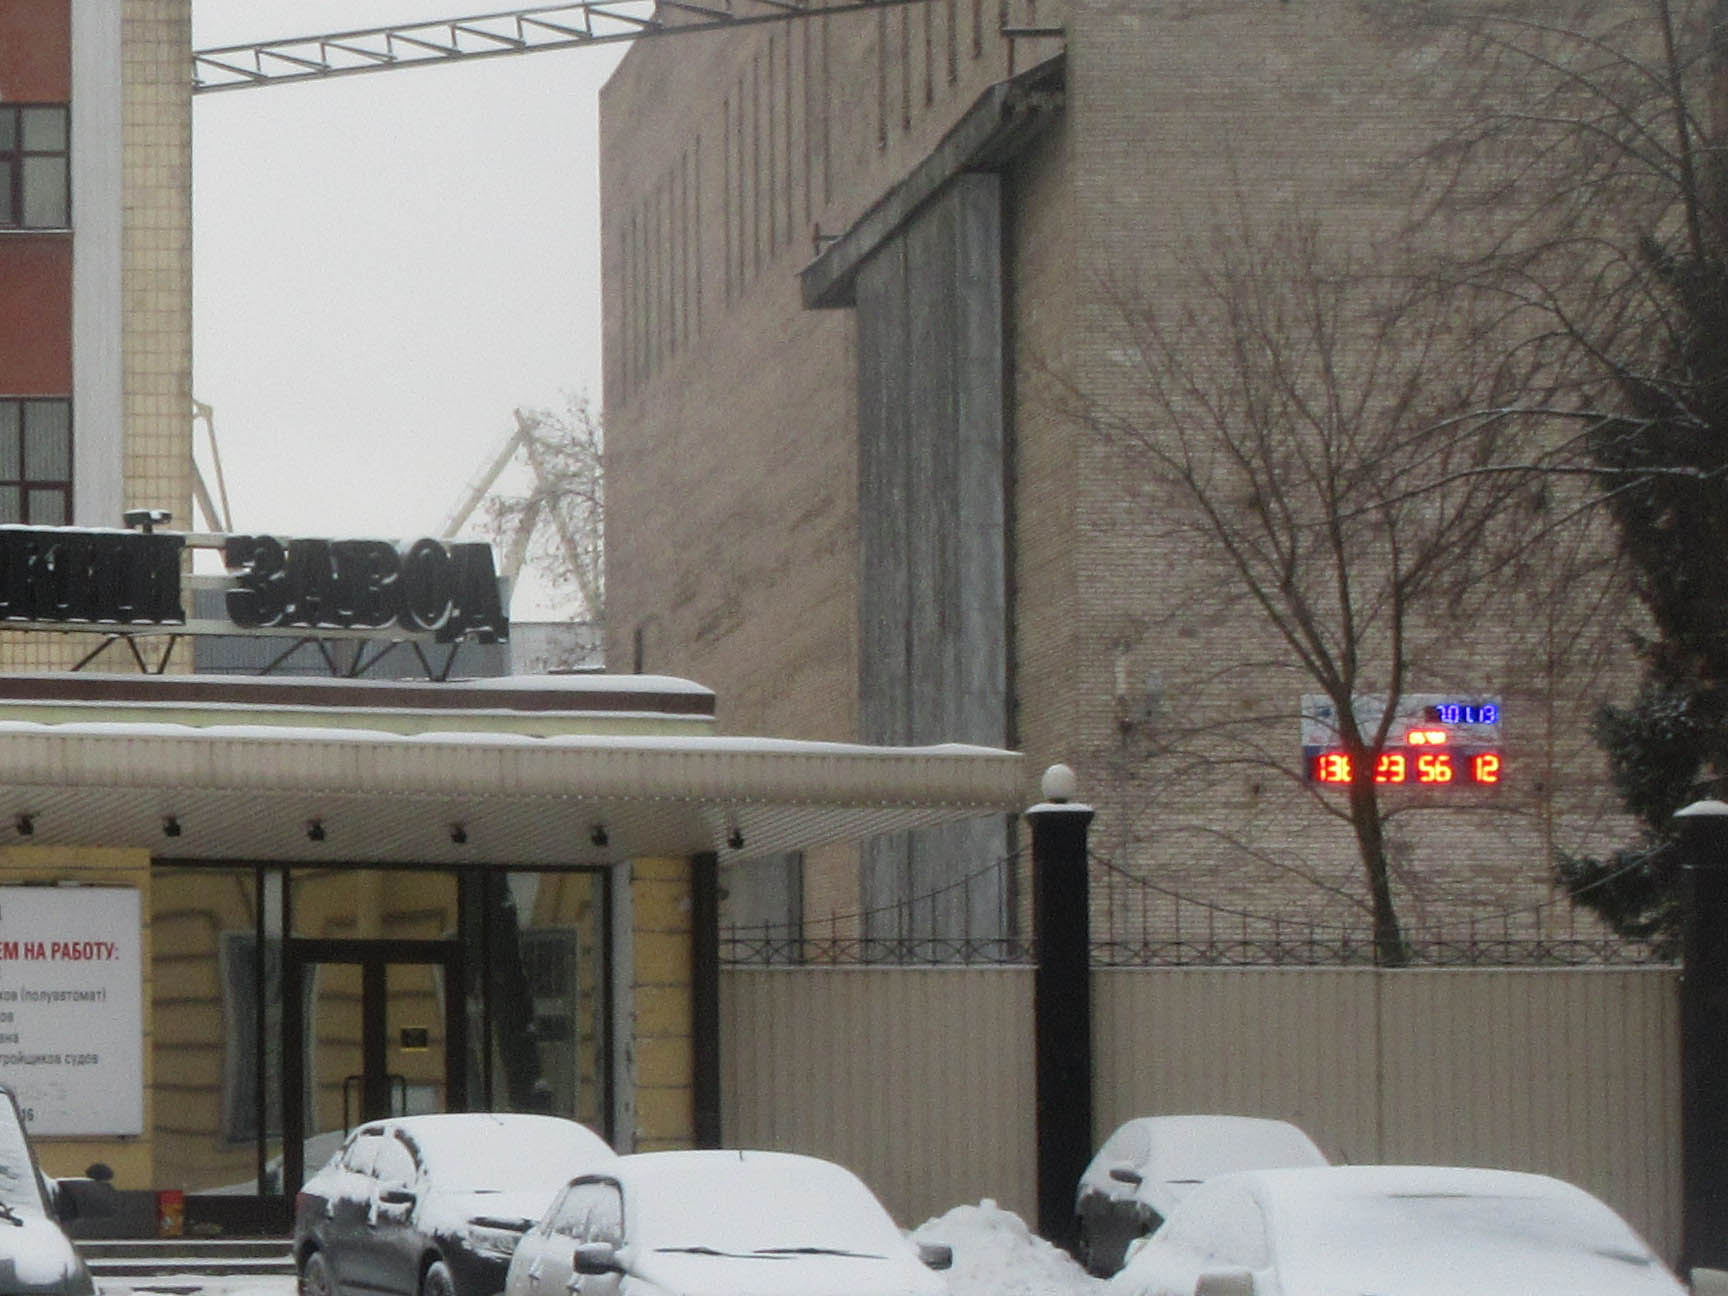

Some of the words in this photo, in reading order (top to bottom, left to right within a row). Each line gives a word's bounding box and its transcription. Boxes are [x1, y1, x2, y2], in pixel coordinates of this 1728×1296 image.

[224, 534, 510, 644] ЗАВОД
[1417, 754, 1454, 783] 56
[24, 942, 46, 960] НА
[51, 943, 119, 961] РАБОТУ:
